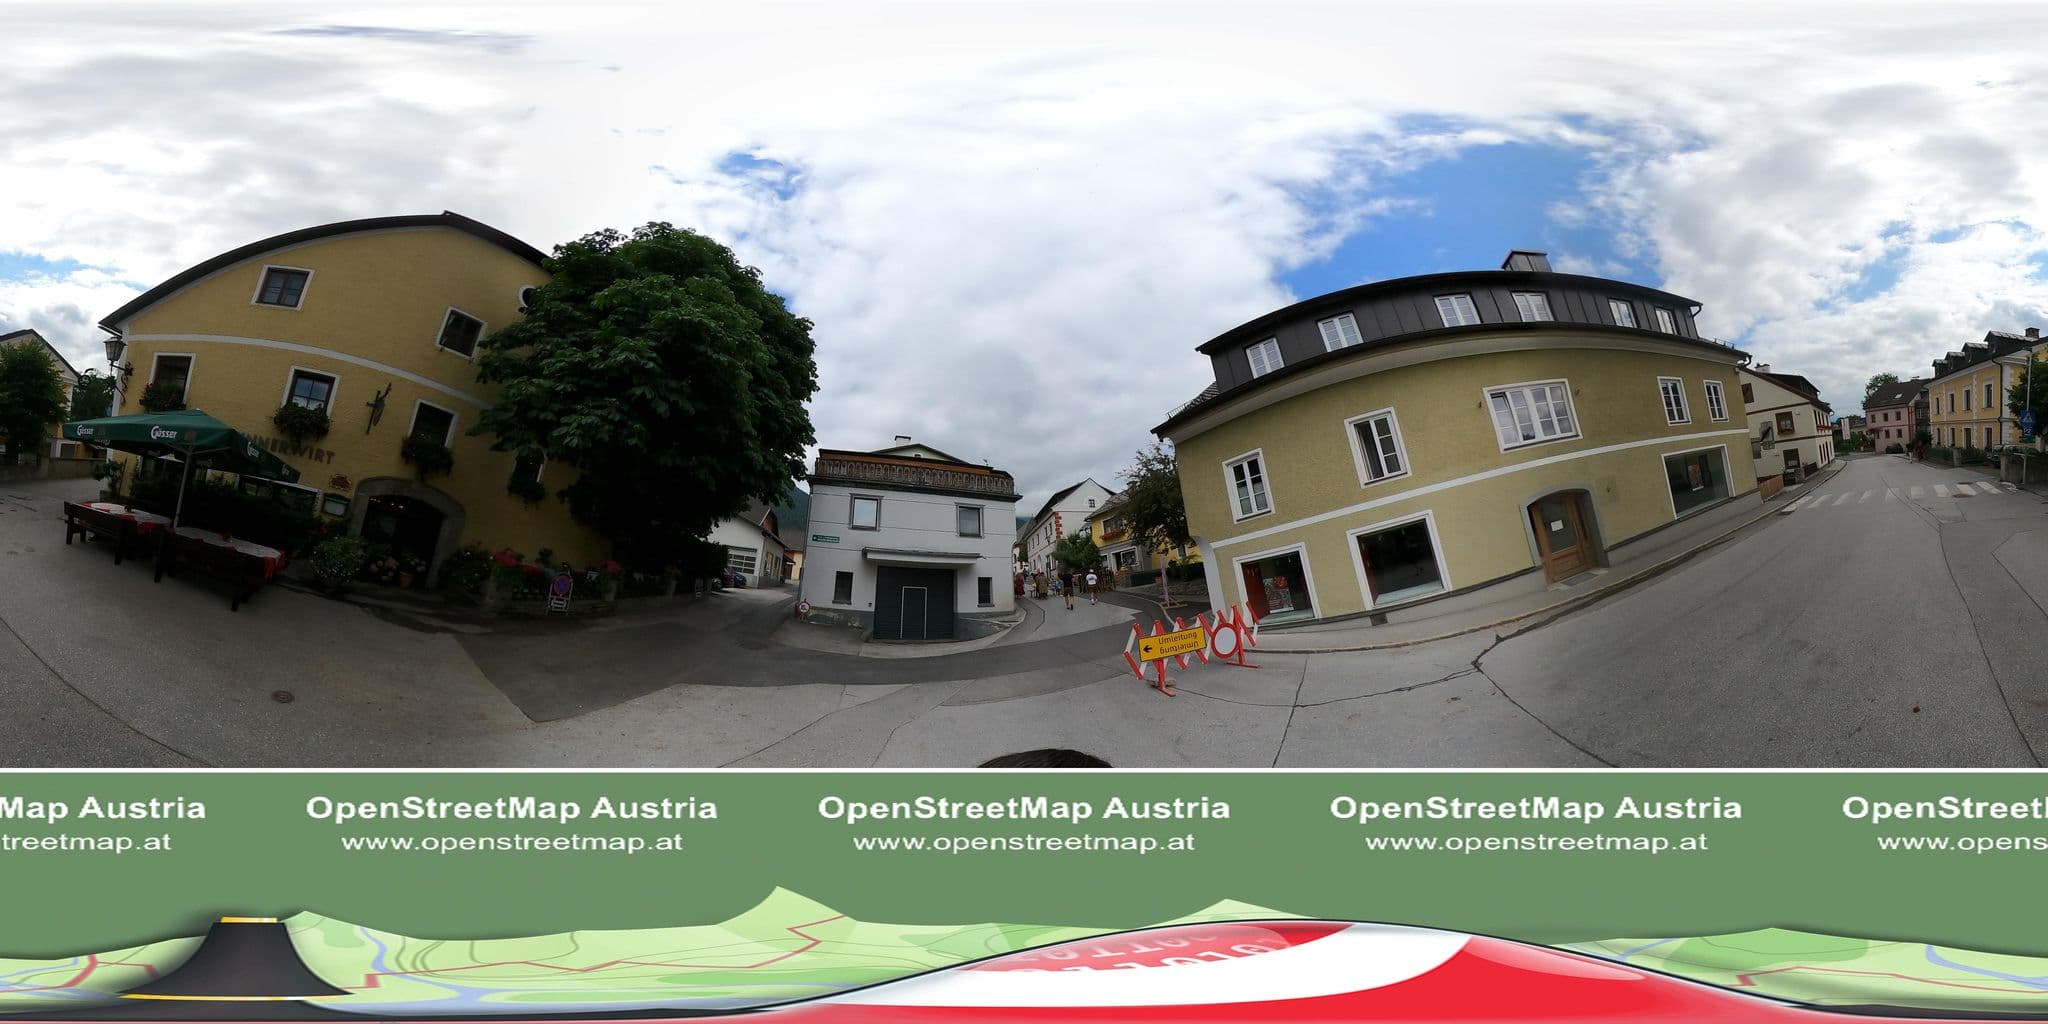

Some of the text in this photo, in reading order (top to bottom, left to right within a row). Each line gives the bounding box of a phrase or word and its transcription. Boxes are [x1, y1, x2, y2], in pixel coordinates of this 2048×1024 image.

[150, 425, 178, 439] Gösser
[1158, 631, 1196, 645] Umleitung
[1159, 640, 1199, 654] Umleitung
